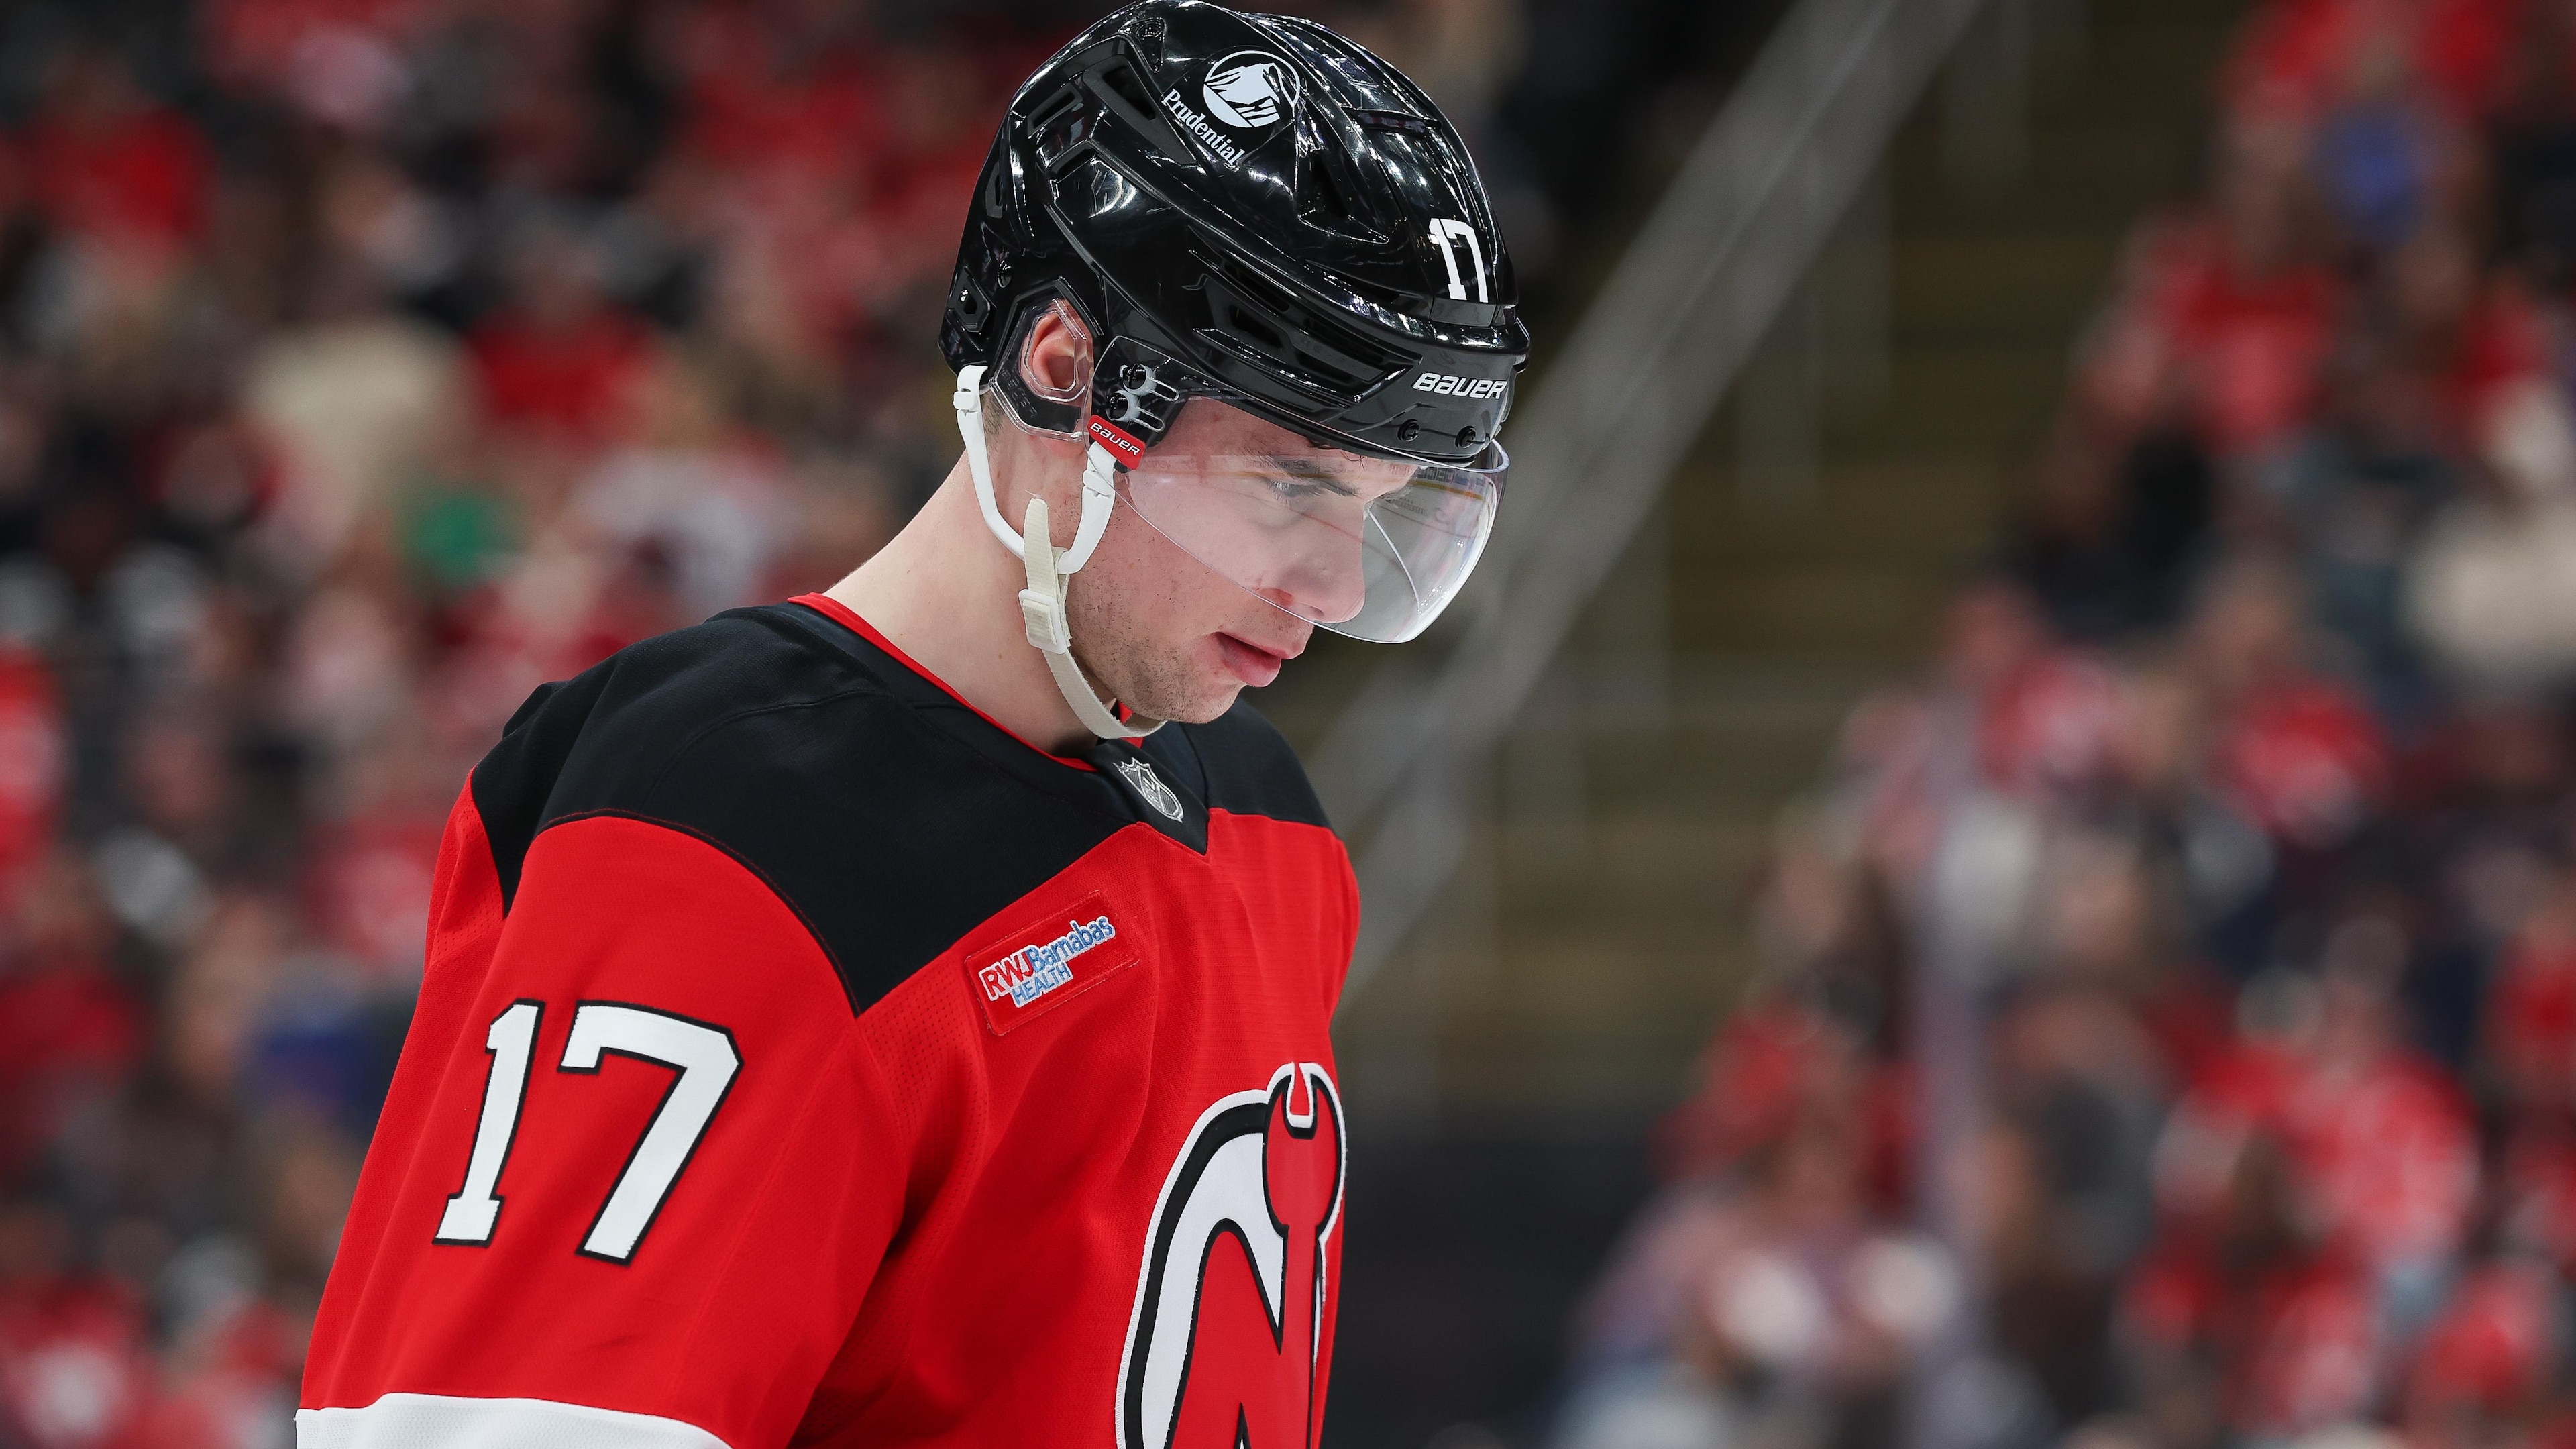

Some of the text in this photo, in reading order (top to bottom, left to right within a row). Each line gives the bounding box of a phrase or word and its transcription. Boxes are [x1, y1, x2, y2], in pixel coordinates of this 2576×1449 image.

[1161, 89, 1245, 165] Prudential
[1428, 218, 1489, 303] 17
[1412, 372, 1507, 400] BAUER
[1089, 422, 1140, 456] BAUER
[1012, 962, 1071, 1006] HEALTH
[431, 998, 745, 1265] 17
